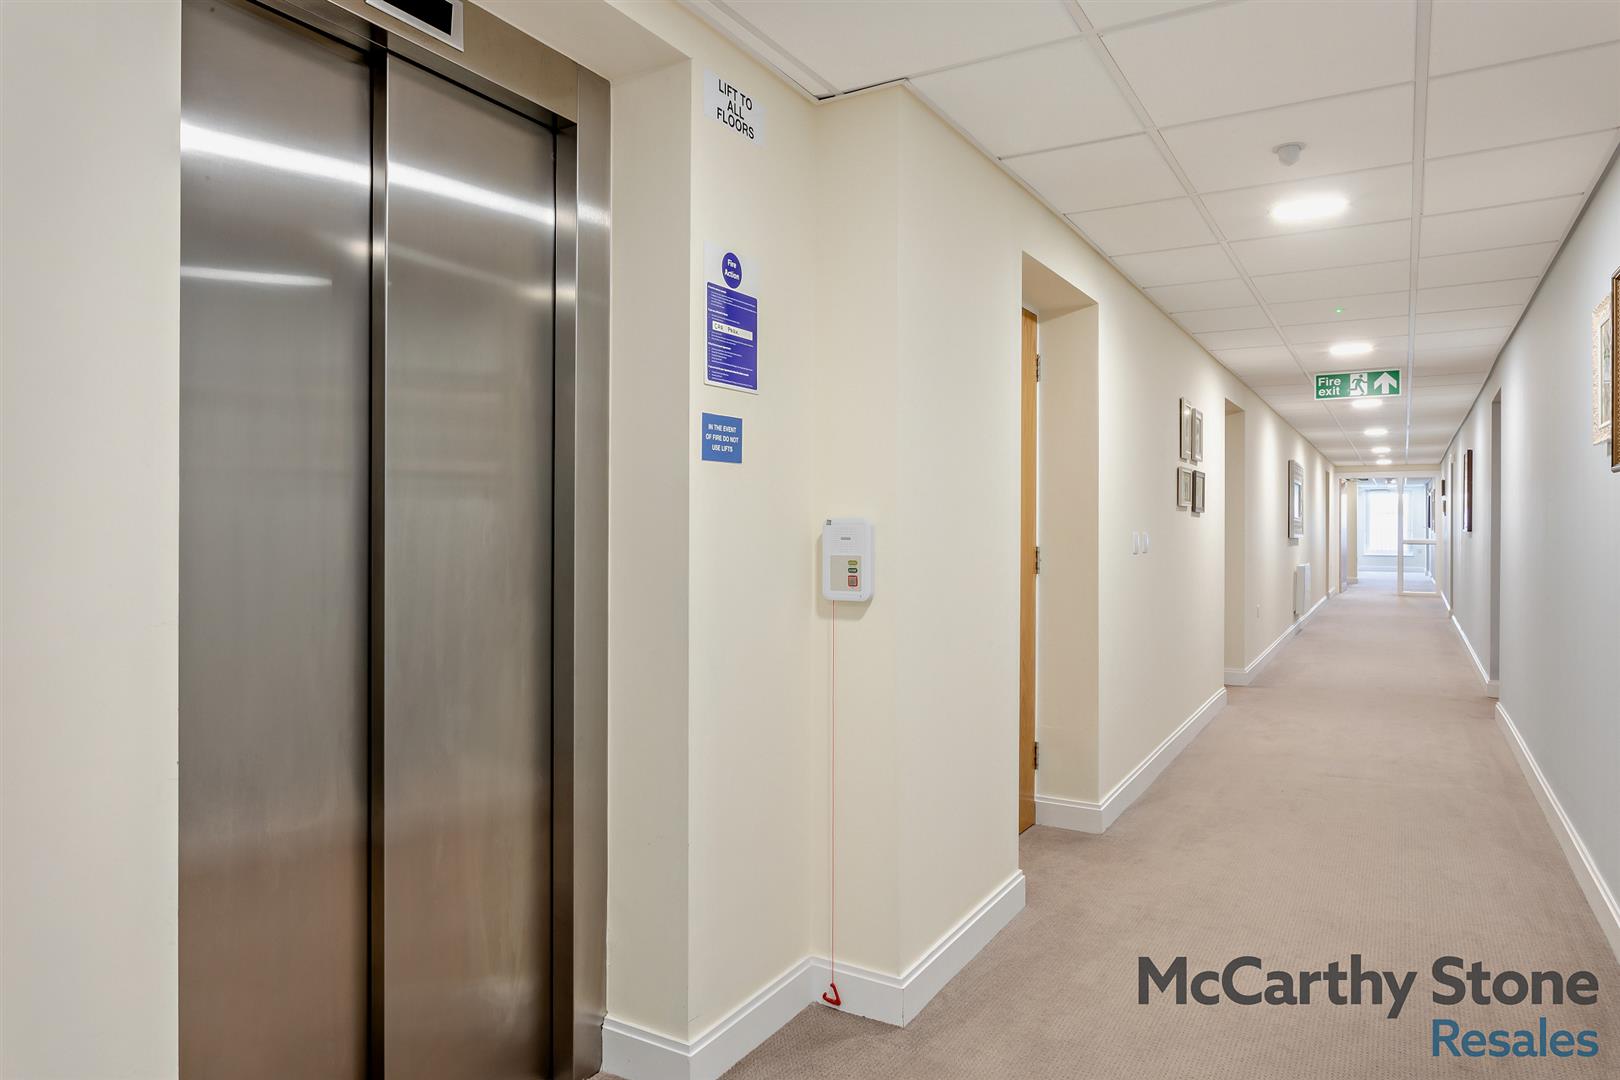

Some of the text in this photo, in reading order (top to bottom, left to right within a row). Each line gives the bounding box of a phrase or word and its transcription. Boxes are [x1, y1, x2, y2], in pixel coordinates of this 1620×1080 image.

[718, 79, 753, 111] LIFT TO
[727, 100, 744, 121] ALL
[717, 107, 754, 140] FLOORS
[727, 259, 737, 269] Fire
[724, 268, 740, 281] Action
[1318, 377, 1341, 387] Fire
[1318, 387, 1340, 396] exit
[723, 425, 737, 433] EVENT
[712, 434, 722, 442] FIRE
[730, 436, 739, 444] NOT
[721, 445, 733, 453] LIFTS
